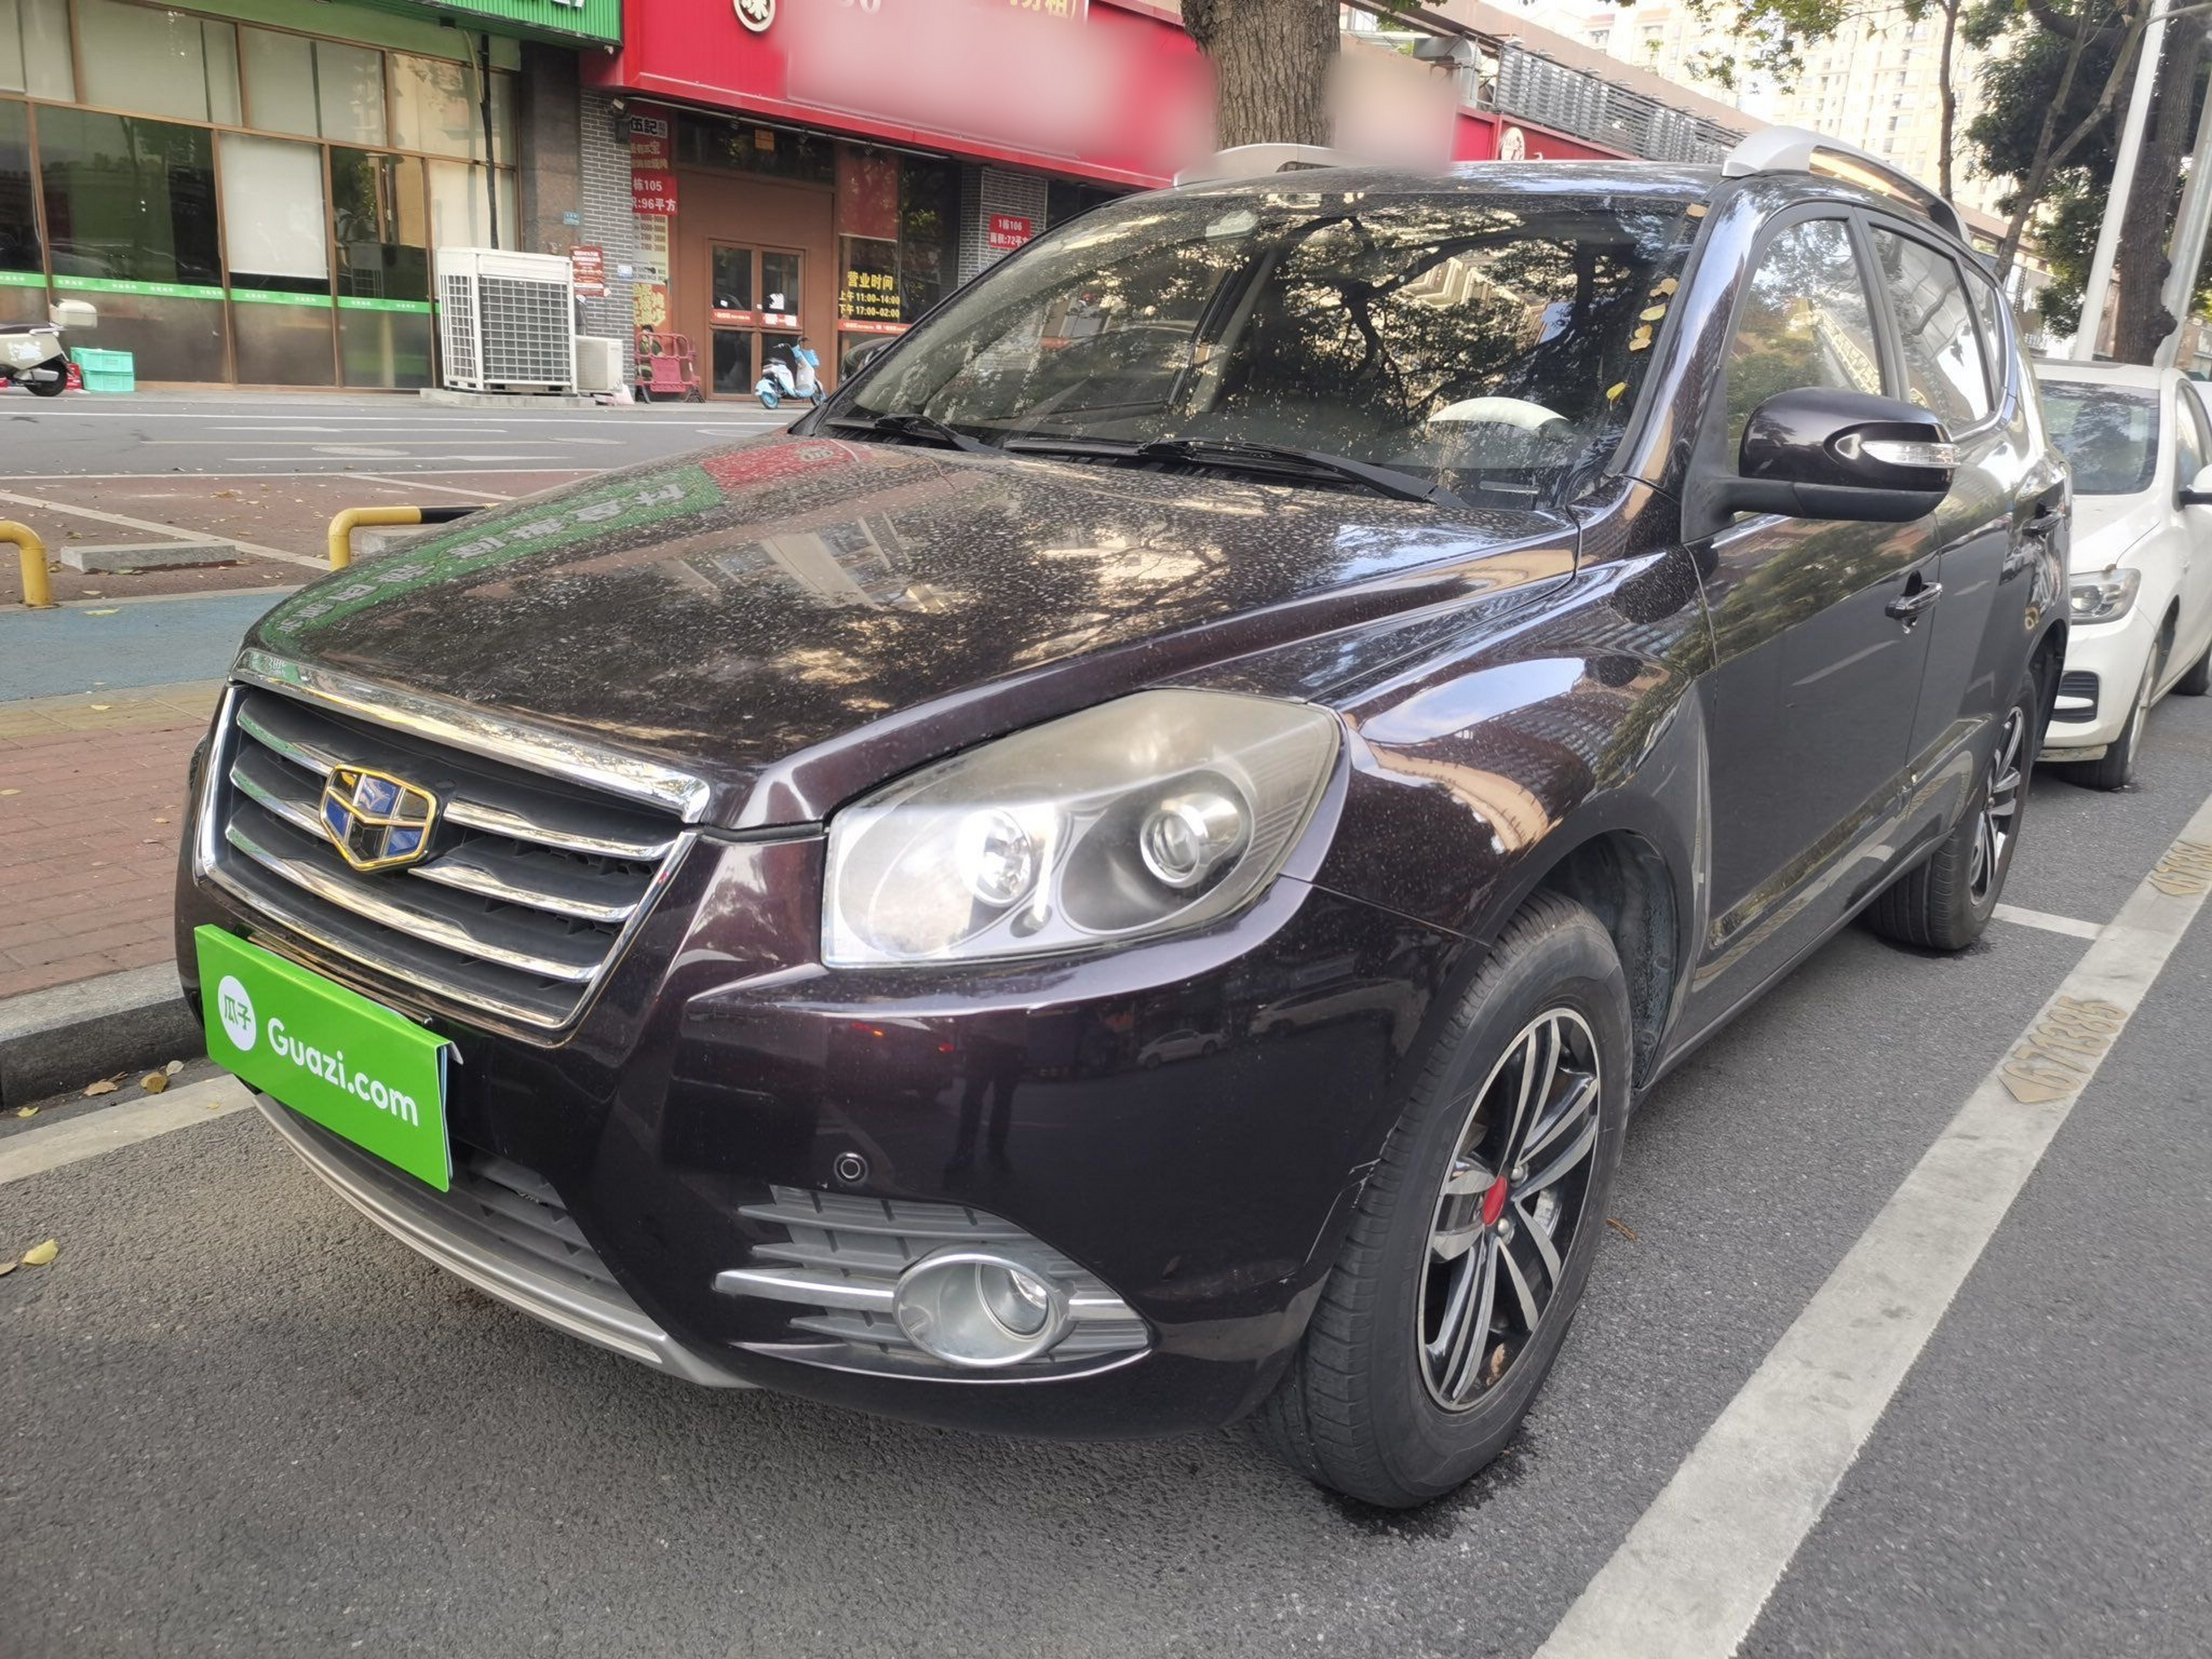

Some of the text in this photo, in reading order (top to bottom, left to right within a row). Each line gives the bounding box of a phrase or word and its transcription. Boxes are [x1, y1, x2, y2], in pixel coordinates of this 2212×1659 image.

[847, 271, 893, 290] 营业时间
[839, 290, 854, 302] 上午
[839, 304, 854, 315] 下午
[224, 994, 252, 1031] 瓜子
[267, 1016, 419, 1127] Guazi.com
